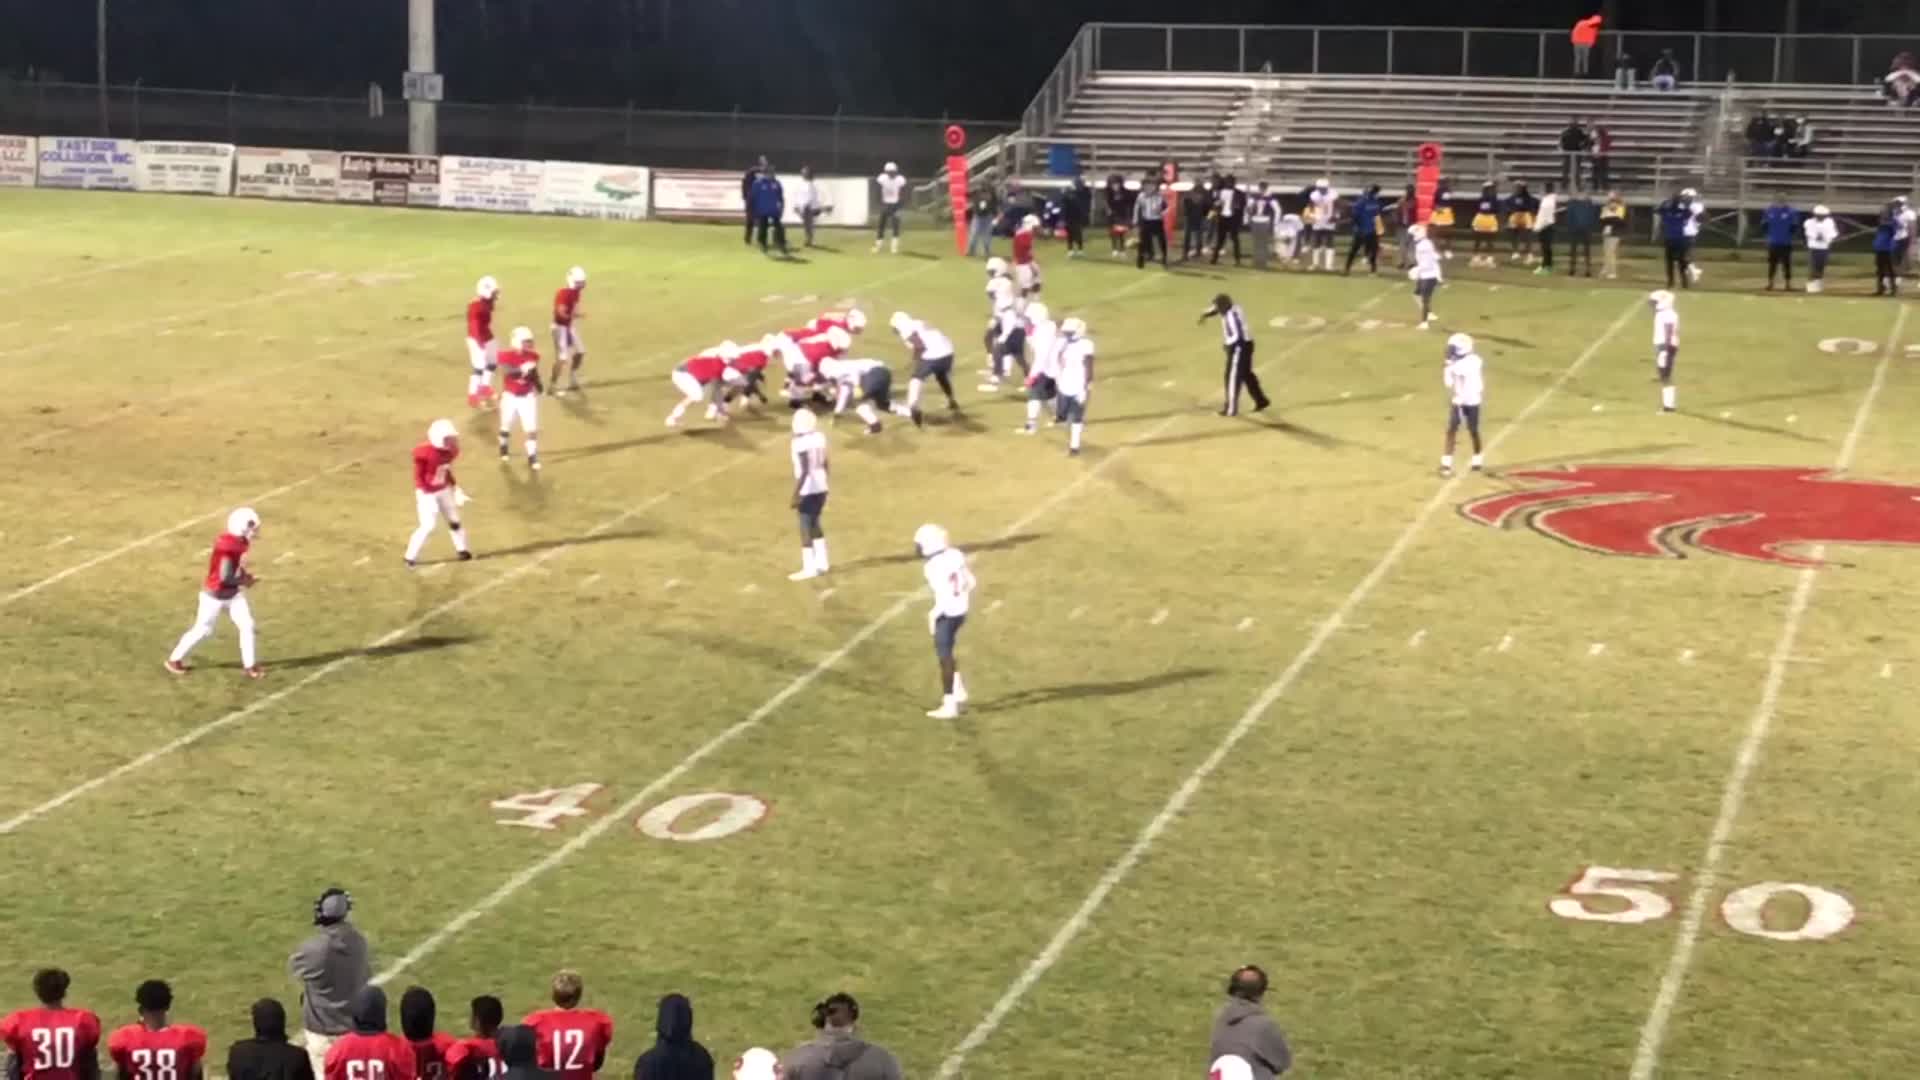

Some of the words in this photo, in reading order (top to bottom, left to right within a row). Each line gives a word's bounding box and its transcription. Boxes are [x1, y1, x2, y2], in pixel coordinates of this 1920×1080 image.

[490, 782, 769, 841] 40
[1549, 866, 1856, 941] 50
[32, 1026, 75, 1070] 30
[131, 1048, 177, 1080] 38
[553, 1029, 585, 1070] 12
